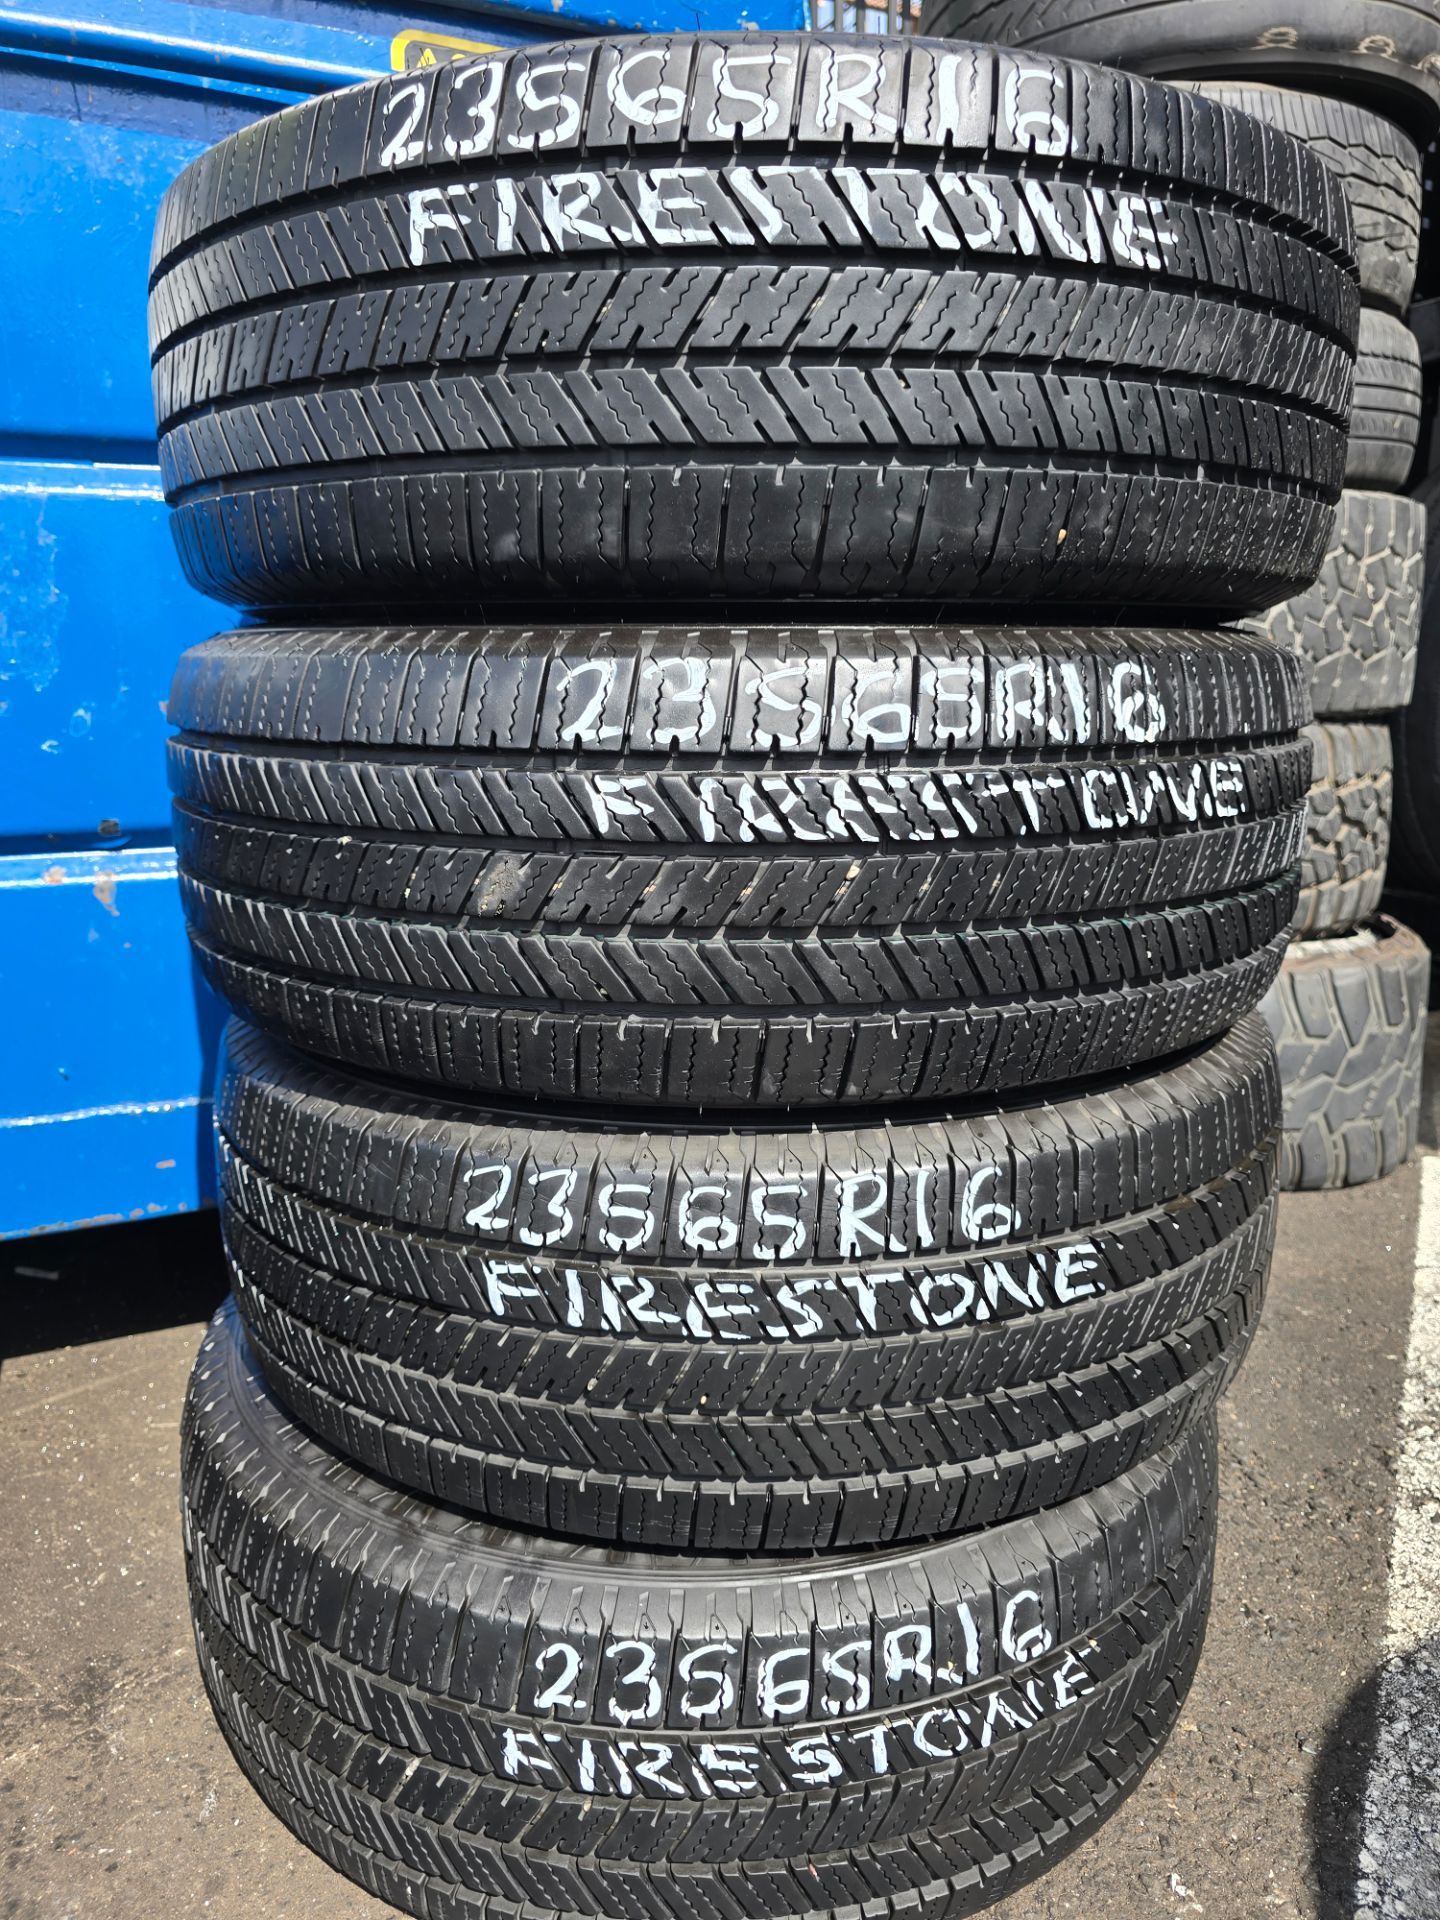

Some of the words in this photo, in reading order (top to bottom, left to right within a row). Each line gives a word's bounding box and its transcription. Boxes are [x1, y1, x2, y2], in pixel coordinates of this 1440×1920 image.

[407, 165, 1178, 270] FIRESTONE
[487, 1243, 1106, 1339] FIRESTONE
[502, 1645, 1098, 1795] FIRESTONE
